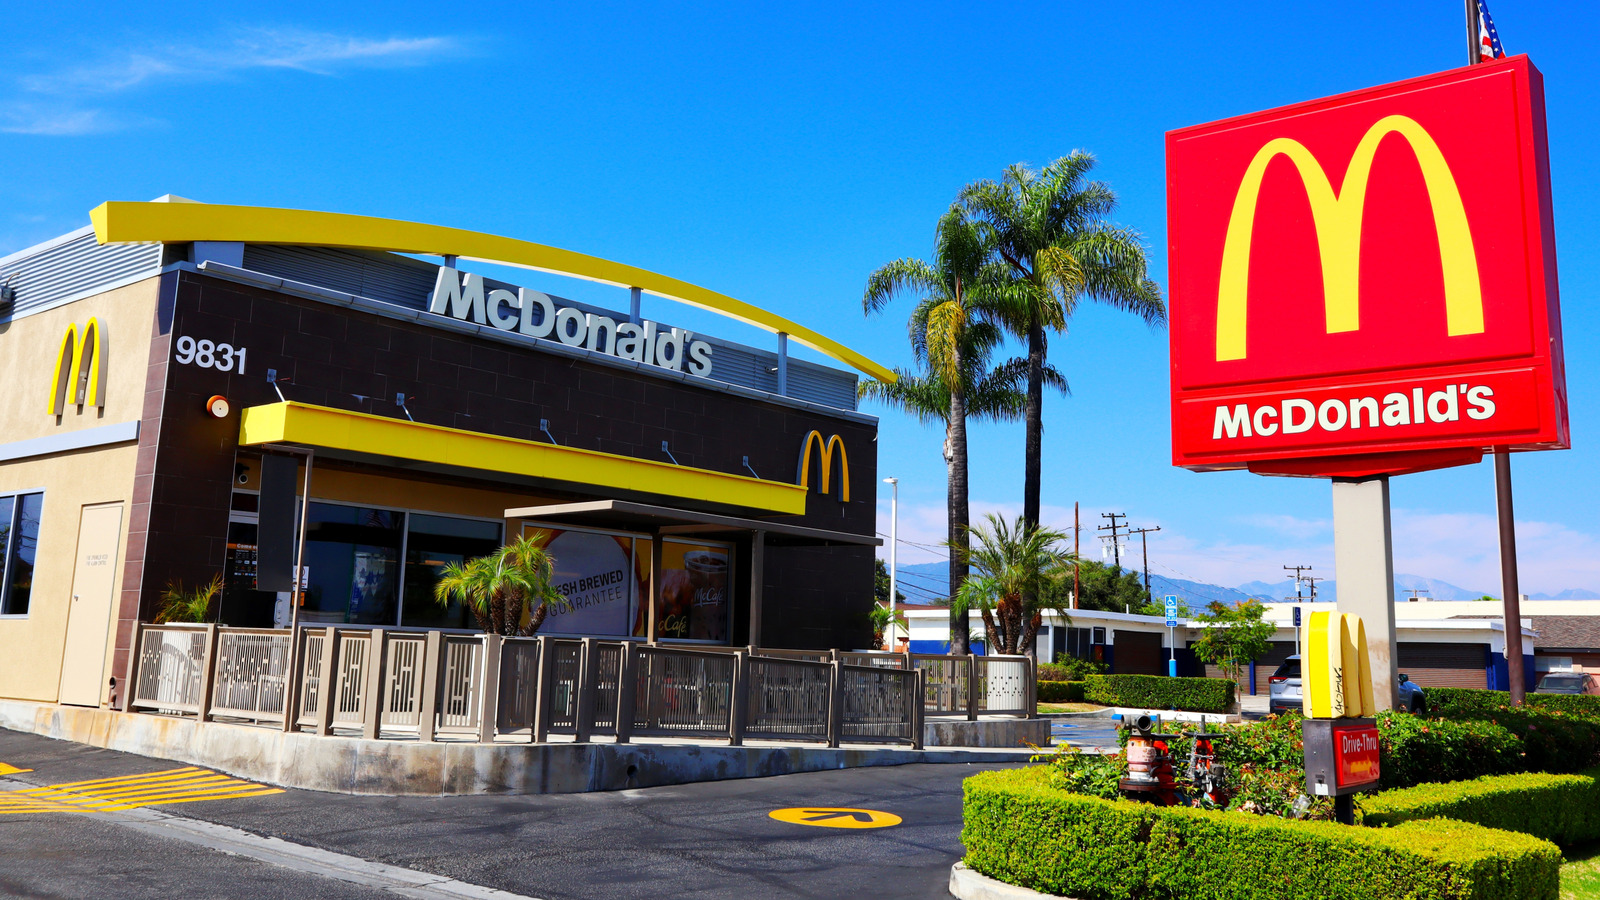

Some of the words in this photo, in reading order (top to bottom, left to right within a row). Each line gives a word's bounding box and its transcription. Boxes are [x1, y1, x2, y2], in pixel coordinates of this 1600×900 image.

[429, 265, 713, 377] McDonald's
[175, 335, 247, 375] 9831
[1212, 383, 1496, 440] McDonald's
[555, 580, 578, 596] ESH
[578, 569, 624, 592] BREWED
[549, 585, 623, 617] GUARANTEE
[658, 614, 687, 638] cCafé
[1342, 733, 1377, 754] Drive-Thru
